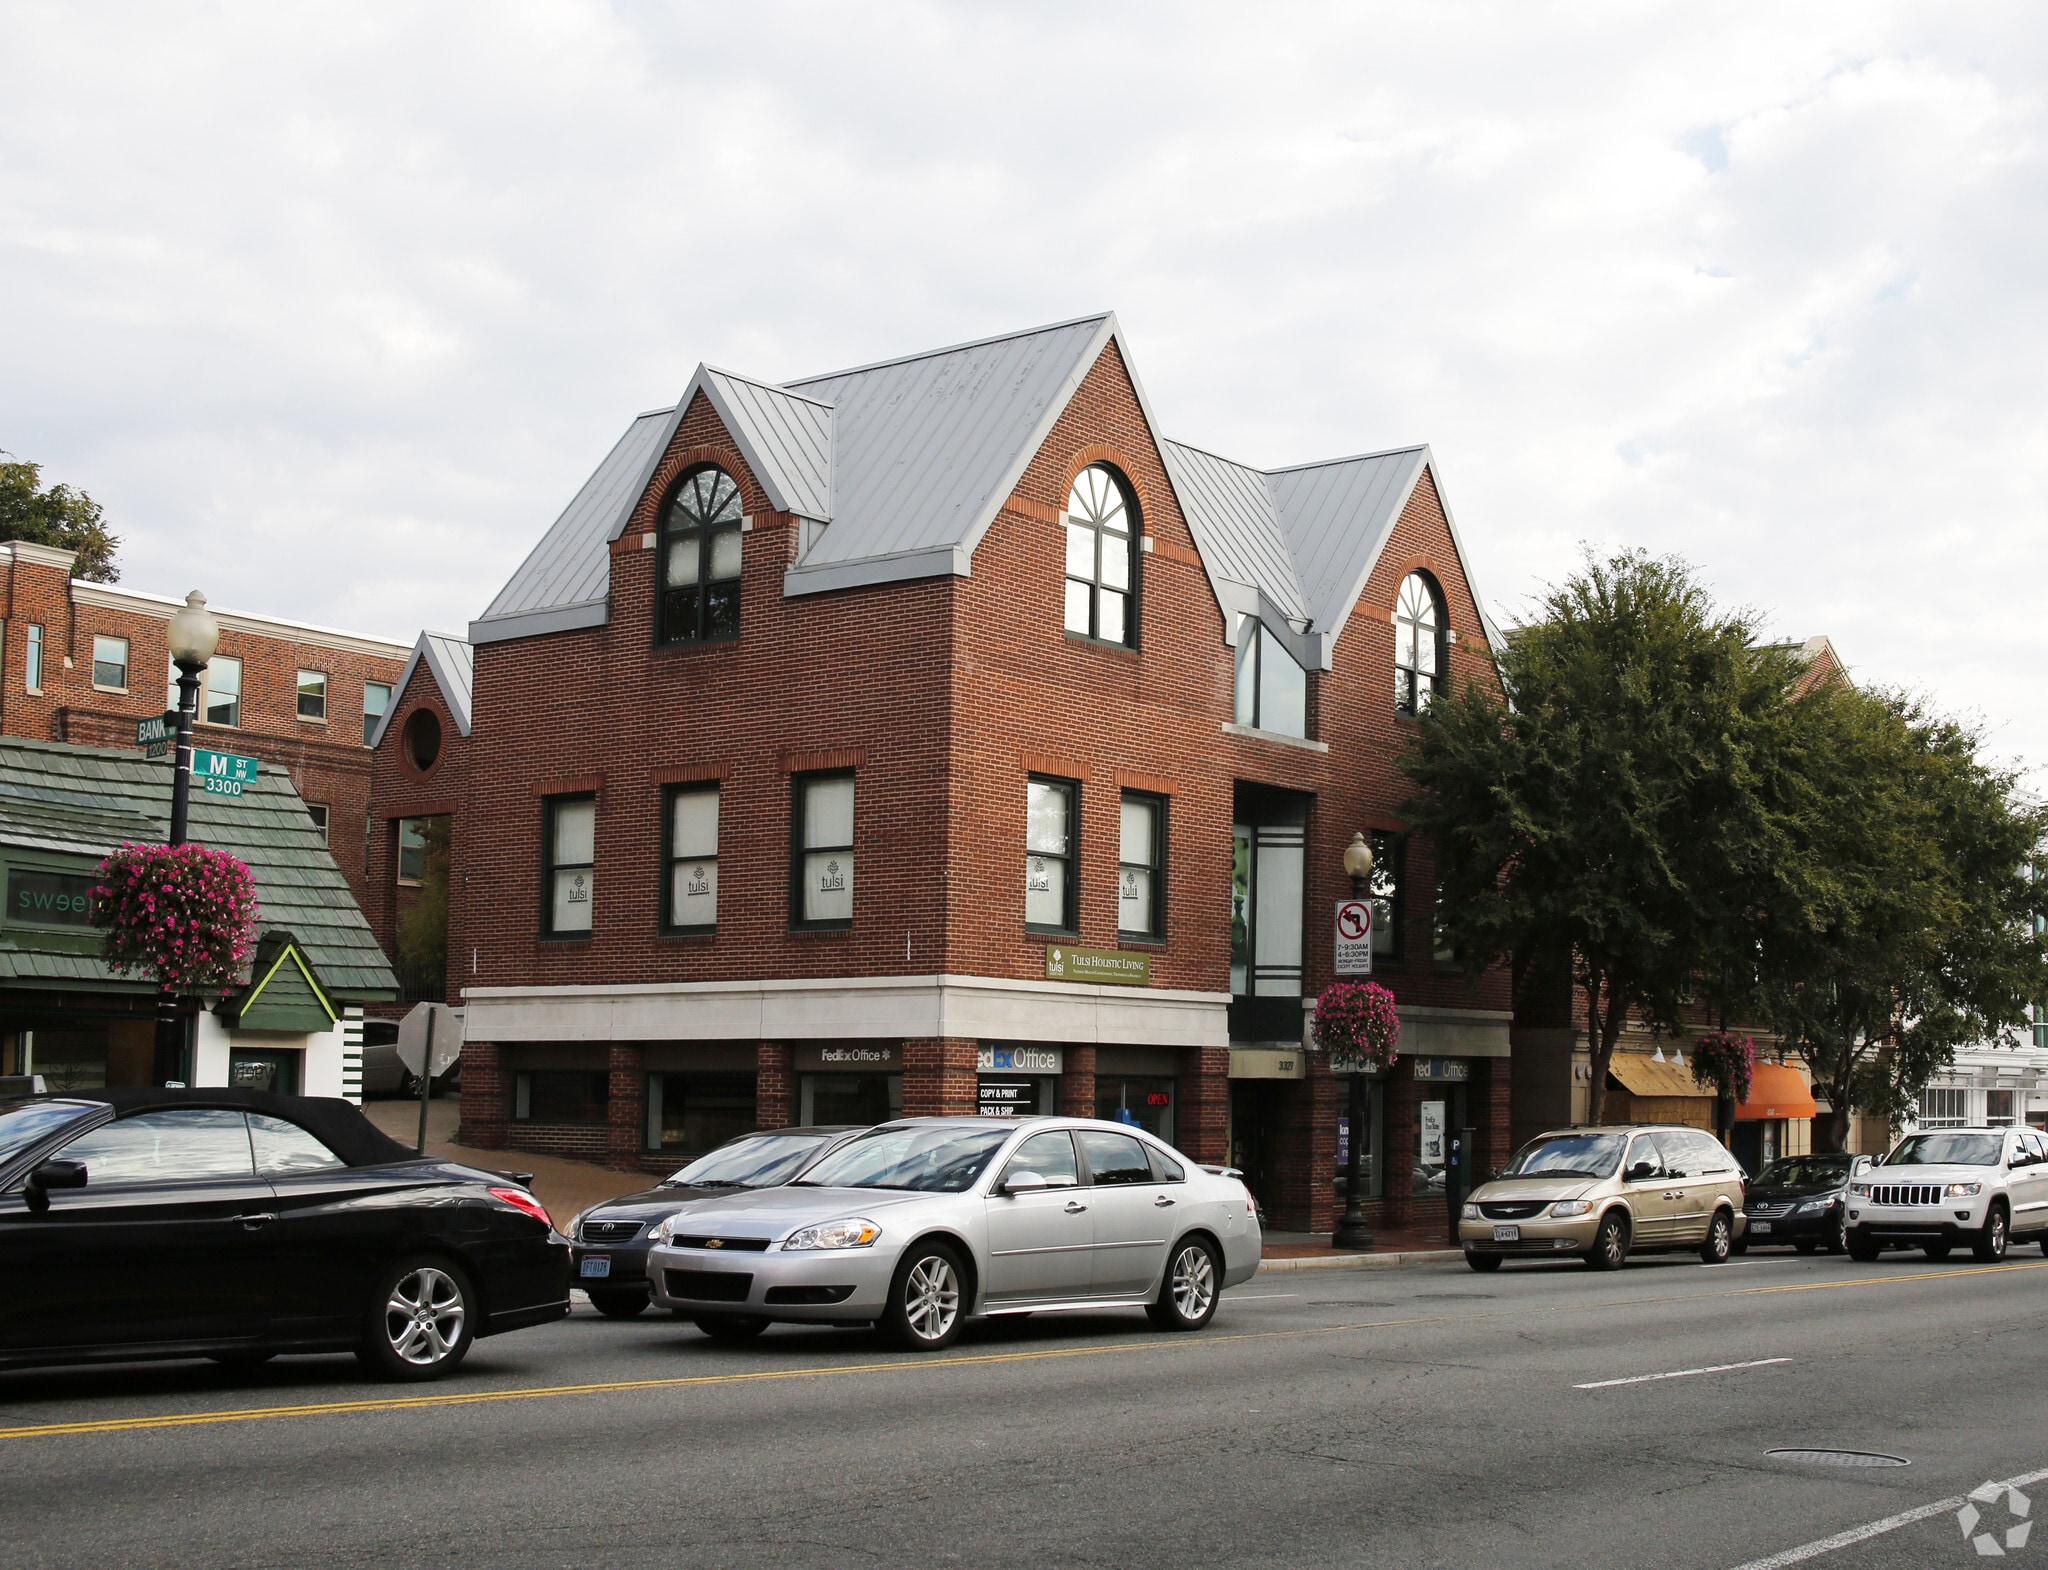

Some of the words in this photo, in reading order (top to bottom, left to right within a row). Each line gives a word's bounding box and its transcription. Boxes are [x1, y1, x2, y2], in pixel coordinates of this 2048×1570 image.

[138, 719, 166, 742] BANK
[148, 742, 167, 757] 1200
[209, 754, 228, 776] M
[236, 759, 248, 769] ST
[235, 769, 248, 780] NW
[206, 778, 241, 795] 3300
[688, 879, 710, 893] tulsi
[821, 874, 844, 889] tulsi
[569, 887, 587, 900] tulsi
[1122, 884, 1138, 897] tulsi
[1049, 961, 1064, 973] tulsi
[1071, 954, 1091, 966] TULSI
[1091, 956, 1122, 969] HOLISTIC
[1122, 958, 1144, 970] LIVING
[821, 1048, 852, 1061] FedEx
[851, 1048, 881, 1061] Office
[977, 1044, 1013, 1068] edEx
[1013, 1047, 1056, 1069] Office
[1278, 1061, 1294, 1071] 3327
[1442, 1060, 1469, 1078] Office
[980, 1088, 995, 1098] COPY
[995, 1089, 1000, 1098] &
[1001, 1089, 1018, 1098] PRINT
[1147, 1093, 1169, 1105] OPEN
[980, 1106, 995, 1115] PACK
[995, 1106, 1000, 1115] &
[1000, 1106, 1014, 1115] SHIP
[1453, 1139, 1460, 1150] P
